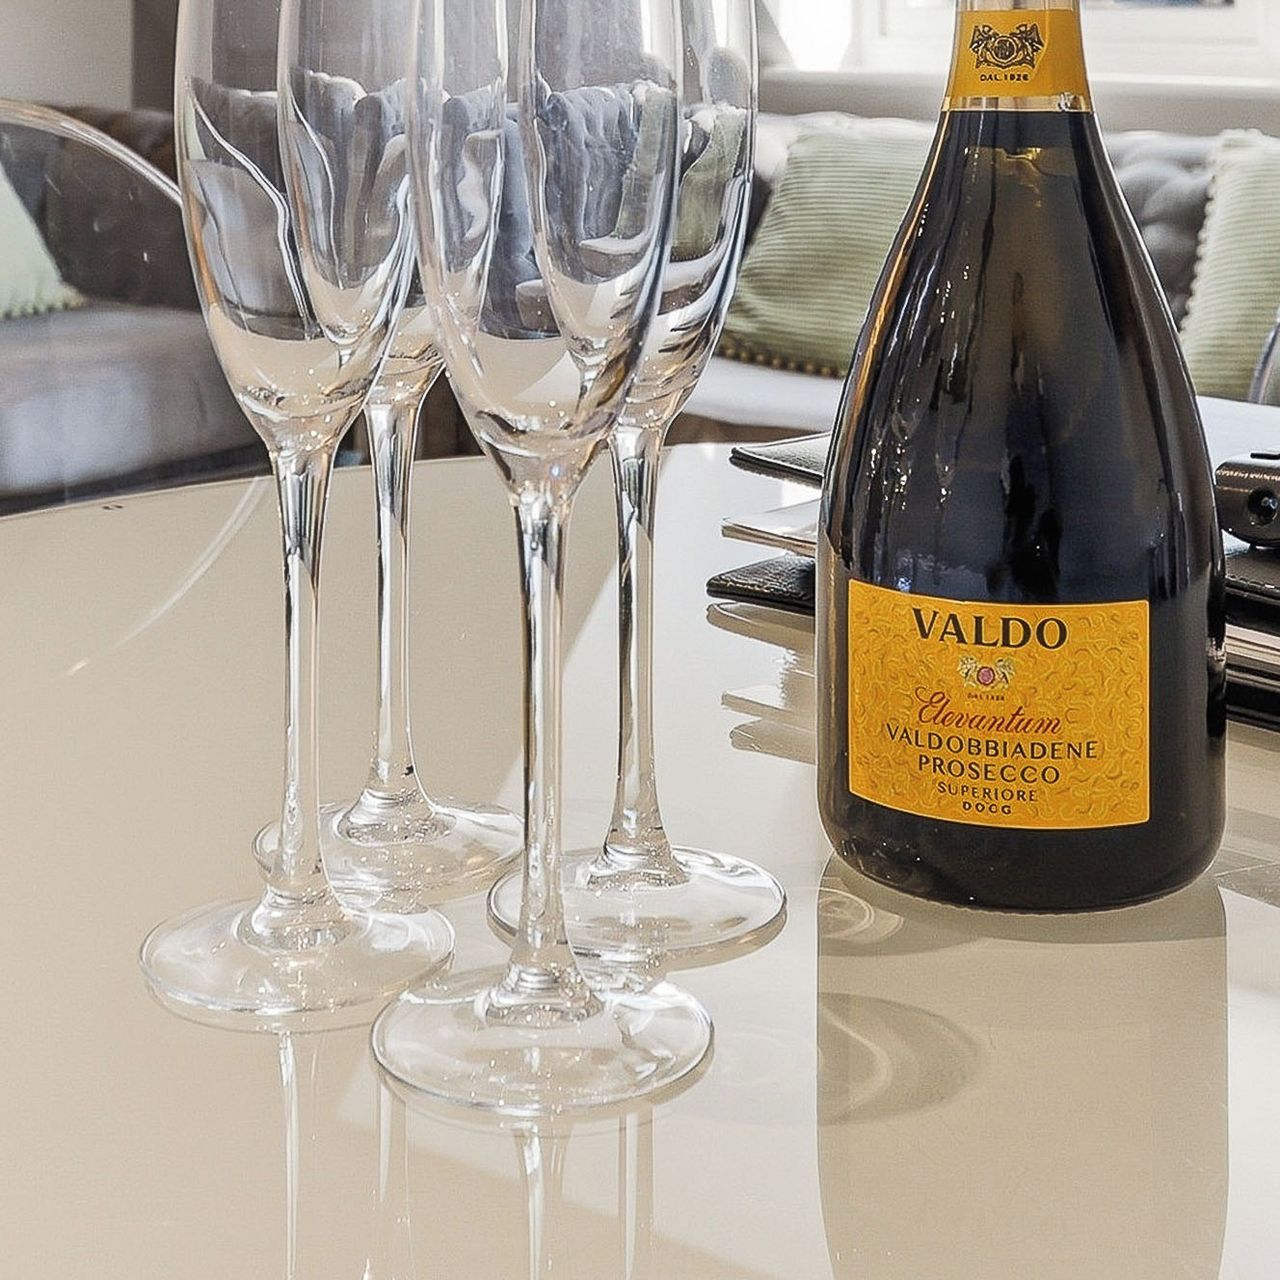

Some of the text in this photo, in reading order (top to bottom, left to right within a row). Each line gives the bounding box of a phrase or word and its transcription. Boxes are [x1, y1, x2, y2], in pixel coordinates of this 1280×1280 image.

[912, 607, 1068, 650] VALDO
[914, 685, 1063, 735] Elevantum
[886, 722, 1099, 760] VALDOBBIADENE
[918, 754, 1061, 785] PROSECCO
[936, 781, 1038, 802] SUPERIORE
[961, 800, 1013, 816] DOCG
